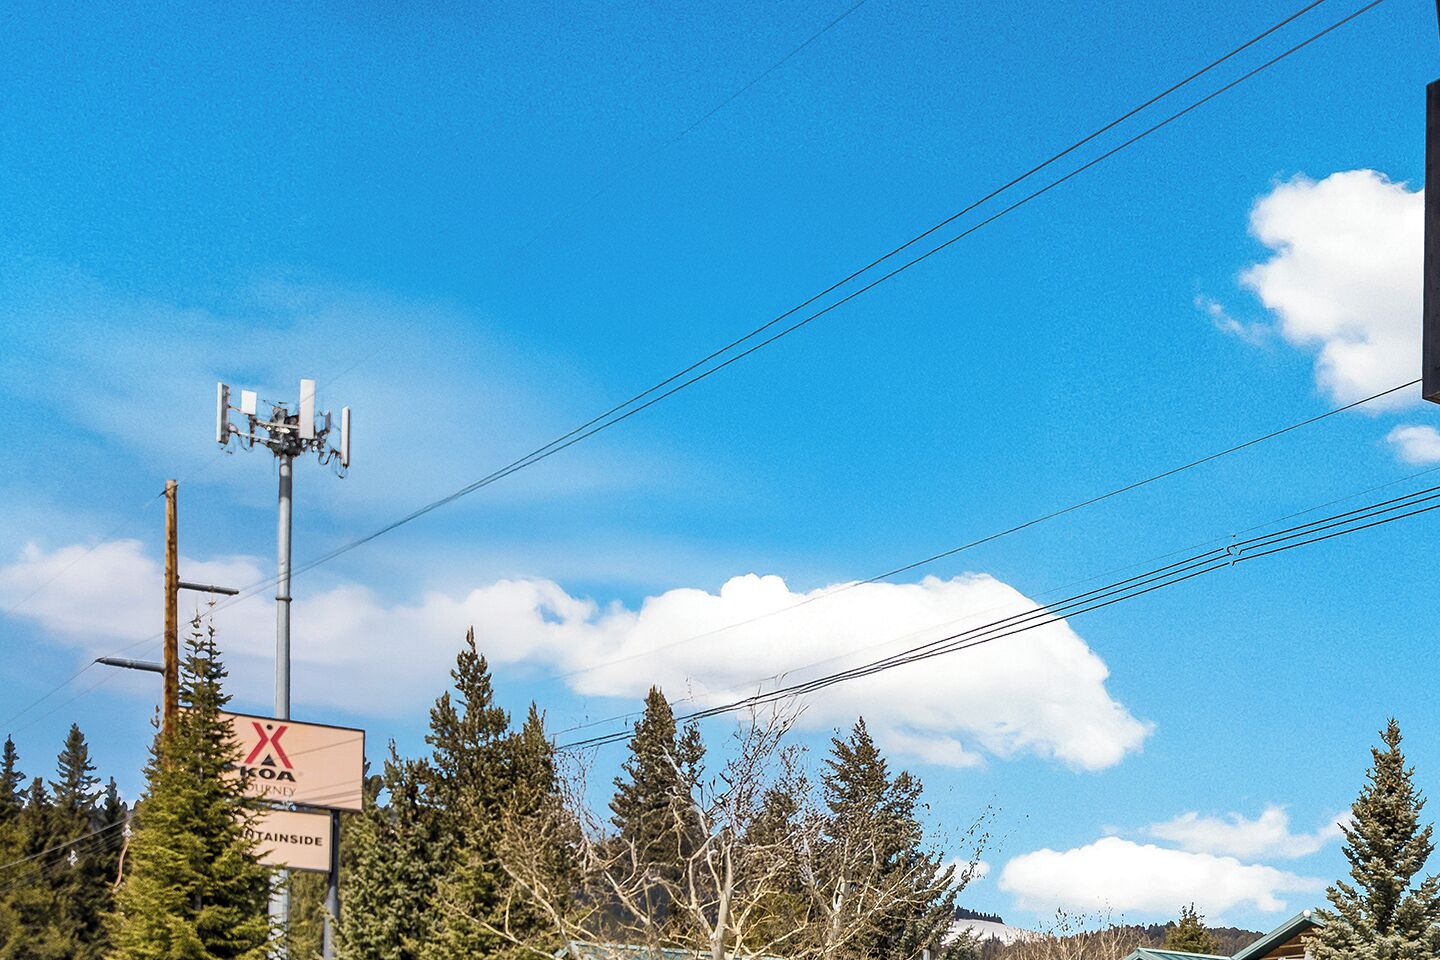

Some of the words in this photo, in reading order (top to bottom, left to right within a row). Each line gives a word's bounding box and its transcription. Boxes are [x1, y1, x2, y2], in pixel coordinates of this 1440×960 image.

[240, 765, 297, 783] KOA
[245, 783, 297, 798] OURNEY
[240, 828, 323, 847] NTAINSIDE
